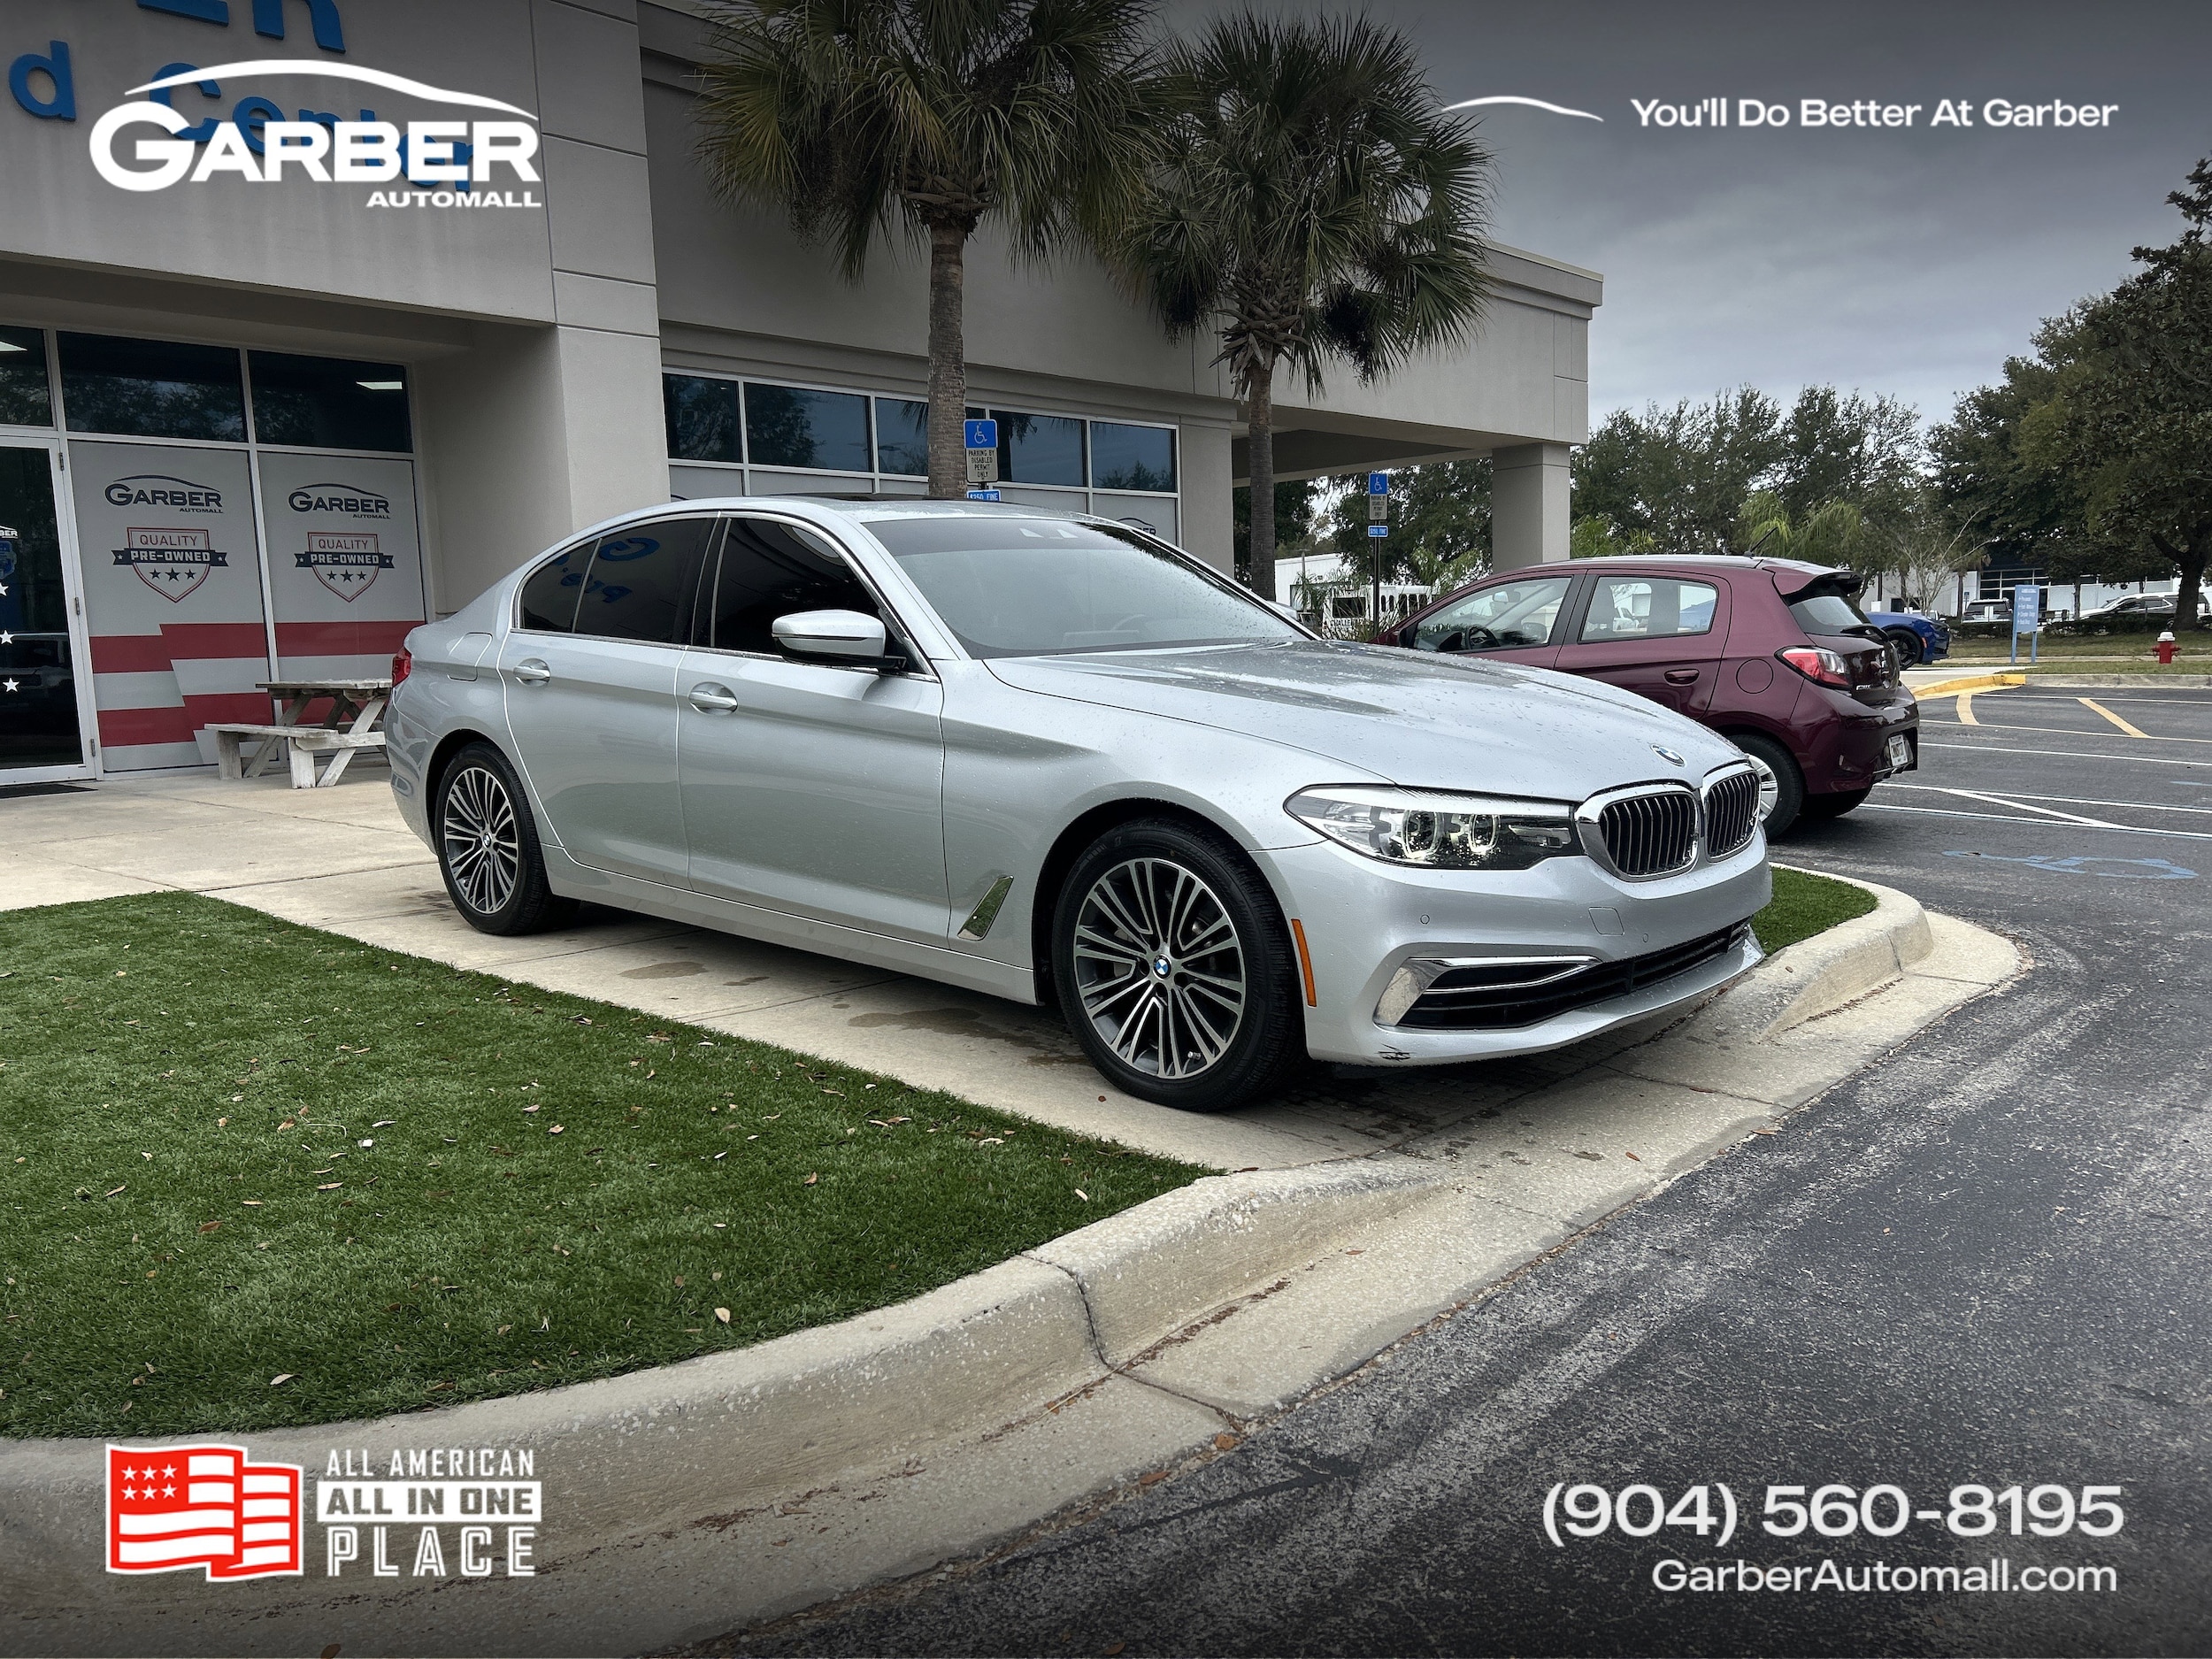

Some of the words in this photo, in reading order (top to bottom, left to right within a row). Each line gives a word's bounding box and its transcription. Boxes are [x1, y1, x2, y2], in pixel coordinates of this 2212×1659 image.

[104, 483, 223, 508] GARBER
[288, 491, 390, 513] GARBER
[140, 534, 197, 547] QUALITY
[319, 539, 368, 549] QUALITY
[130, 550, 211, 562] PRE-OWNED
[310, 554, 380, 564] PRE-OWNED
